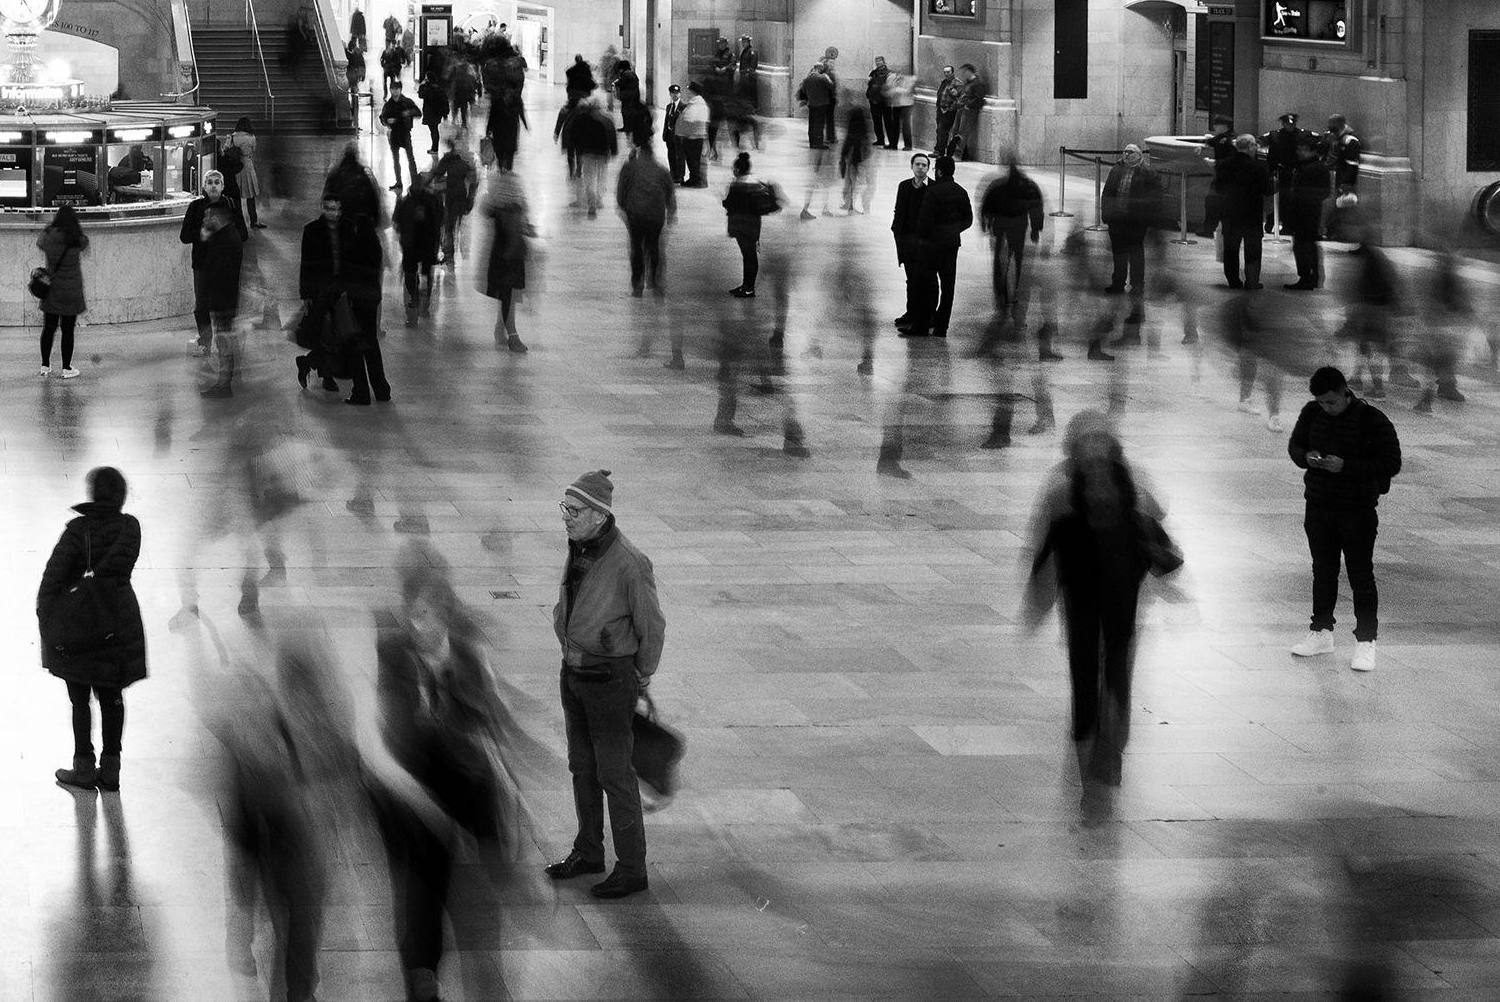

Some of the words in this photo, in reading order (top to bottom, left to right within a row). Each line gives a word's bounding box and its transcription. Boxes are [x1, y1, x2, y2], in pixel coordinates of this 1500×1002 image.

[61, 22, 73, 30] 100
[75, 24, 86, 34] TO
[88, 29, 99, 37] 117
